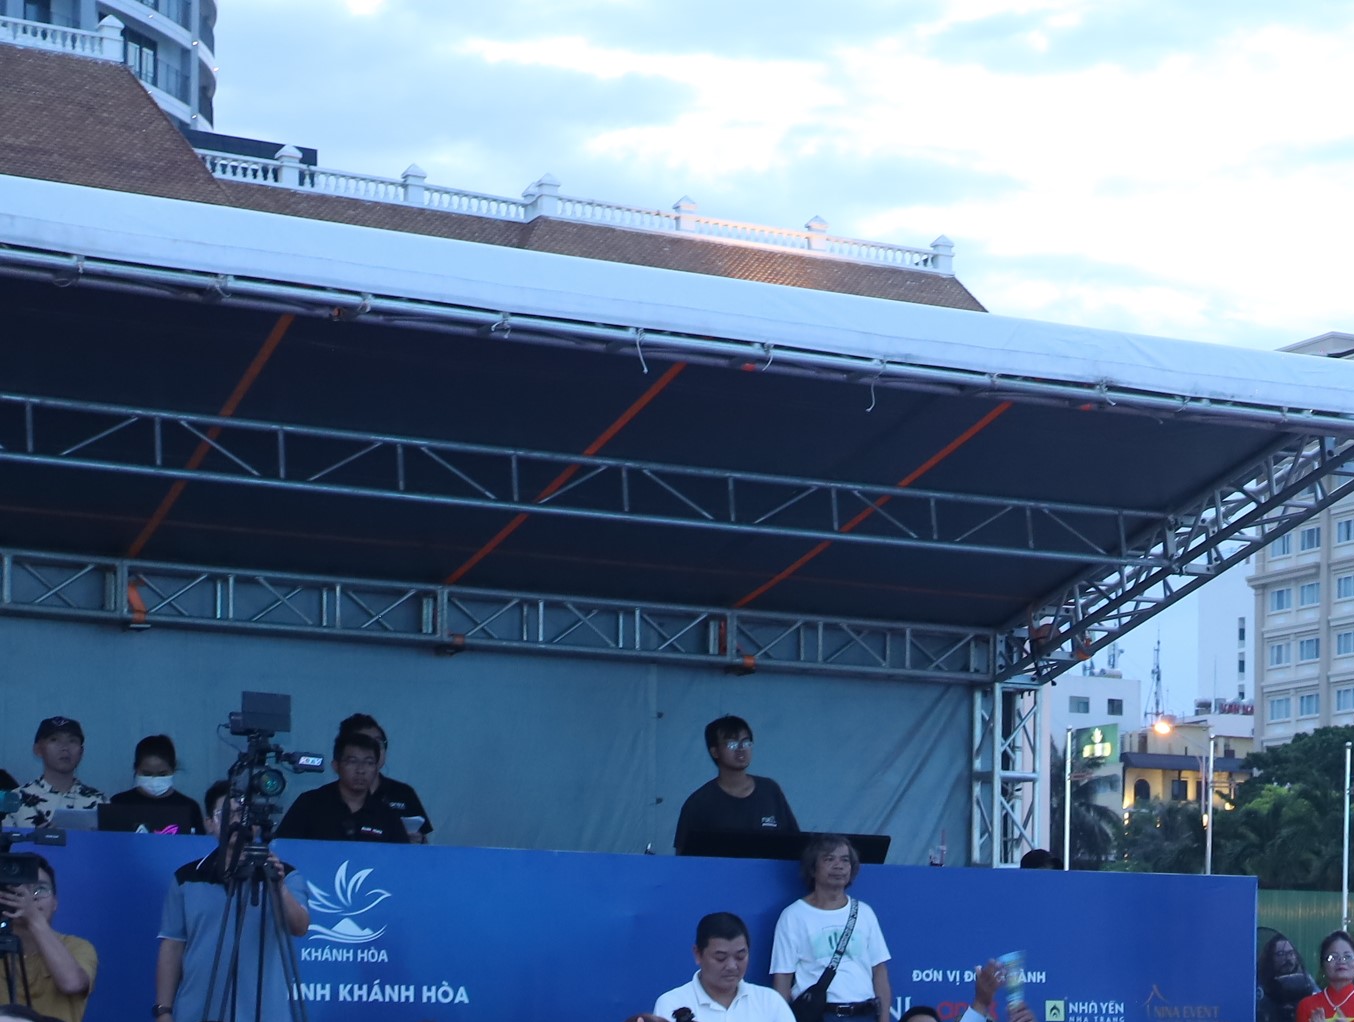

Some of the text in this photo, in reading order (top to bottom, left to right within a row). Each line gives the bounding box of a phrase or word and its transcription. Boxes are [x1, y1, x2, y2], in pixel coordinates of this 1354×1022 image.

[301, 945, 388, 963] KHÁNH HÒA
[912, 968, 943, 982] ĐƠN
[947, 970, 959, 985] VỊ
[338, 979, 414, 1004] KHÁNH
[421, 980, 470, 1004] HÒA
[1069, 1015, 1088, 1022] NHA
[1183, 1005, 1219, 1018] EVENT
